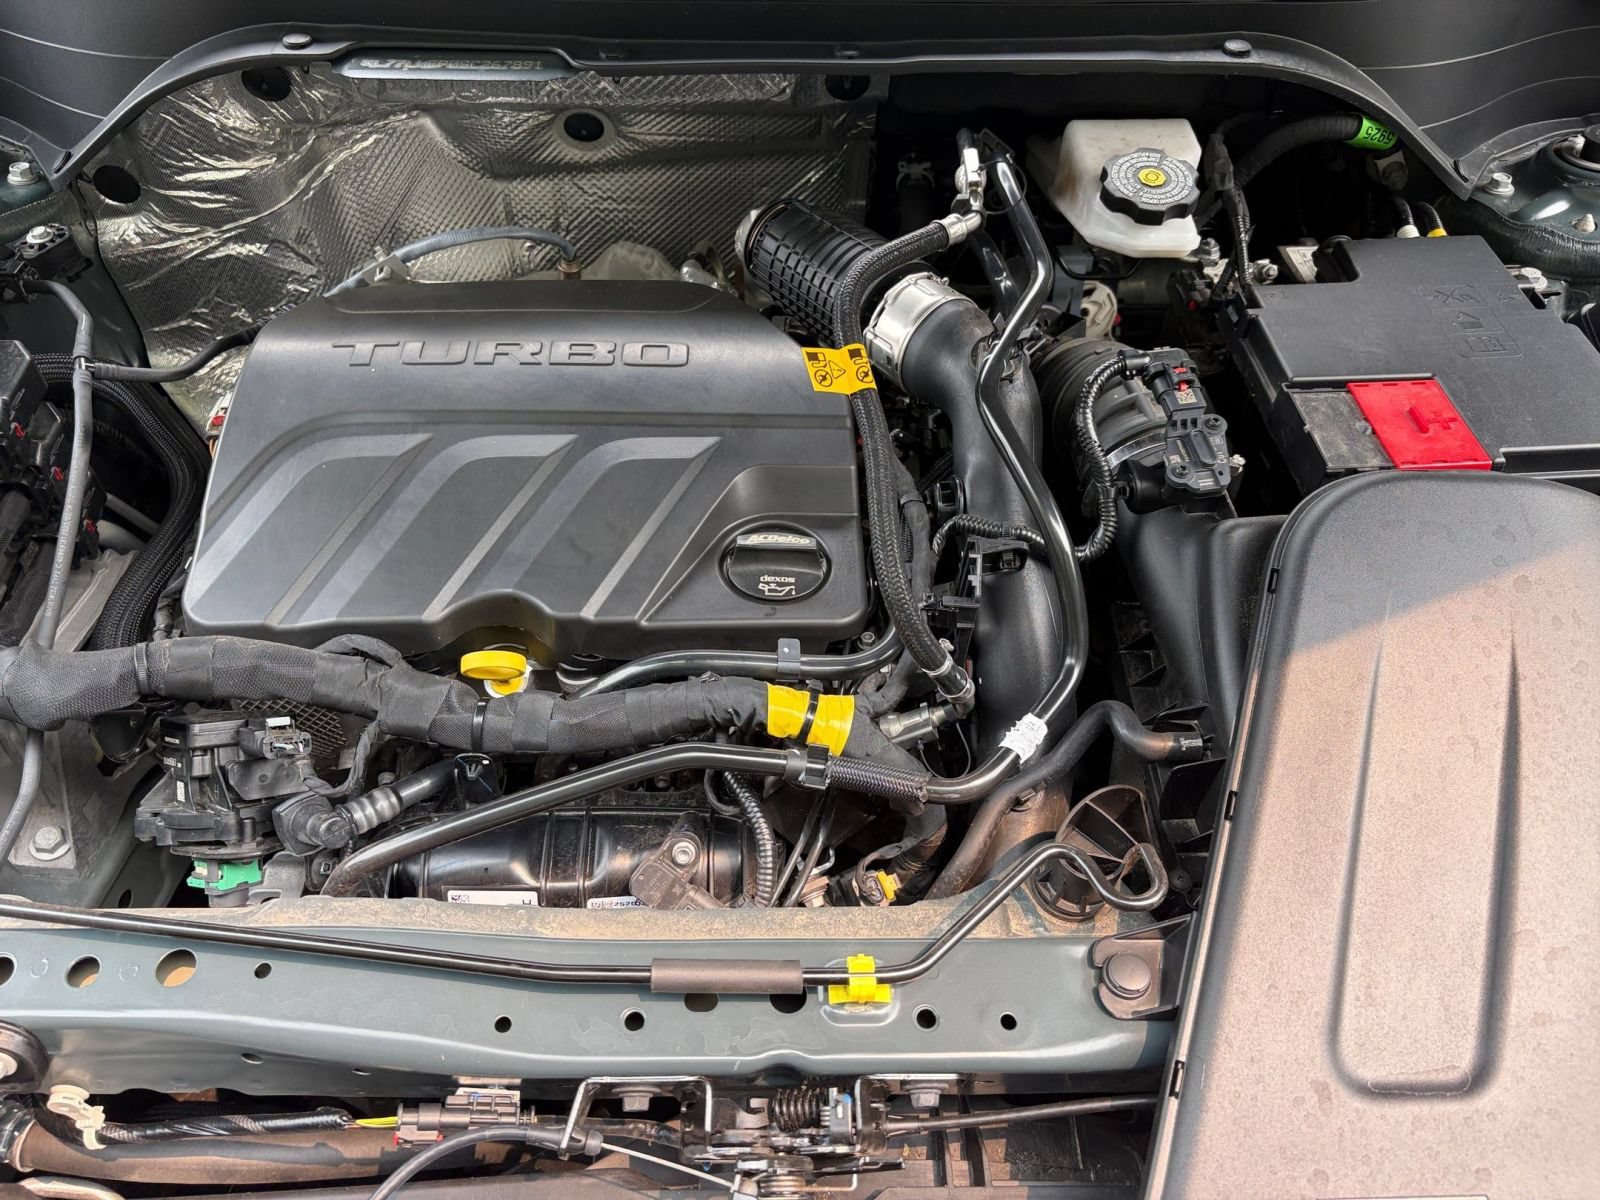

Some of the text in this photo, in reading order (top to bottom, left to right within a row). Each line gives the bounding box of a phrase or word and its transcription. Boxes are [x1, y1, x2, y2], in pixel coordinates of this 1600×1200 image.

[1363, 126, 1395, 144] 5925
[331, 339, 691, 367] TURBO
[747, 535, 810, 544] ACDelco
[759, 574, 796, 583] dexos
